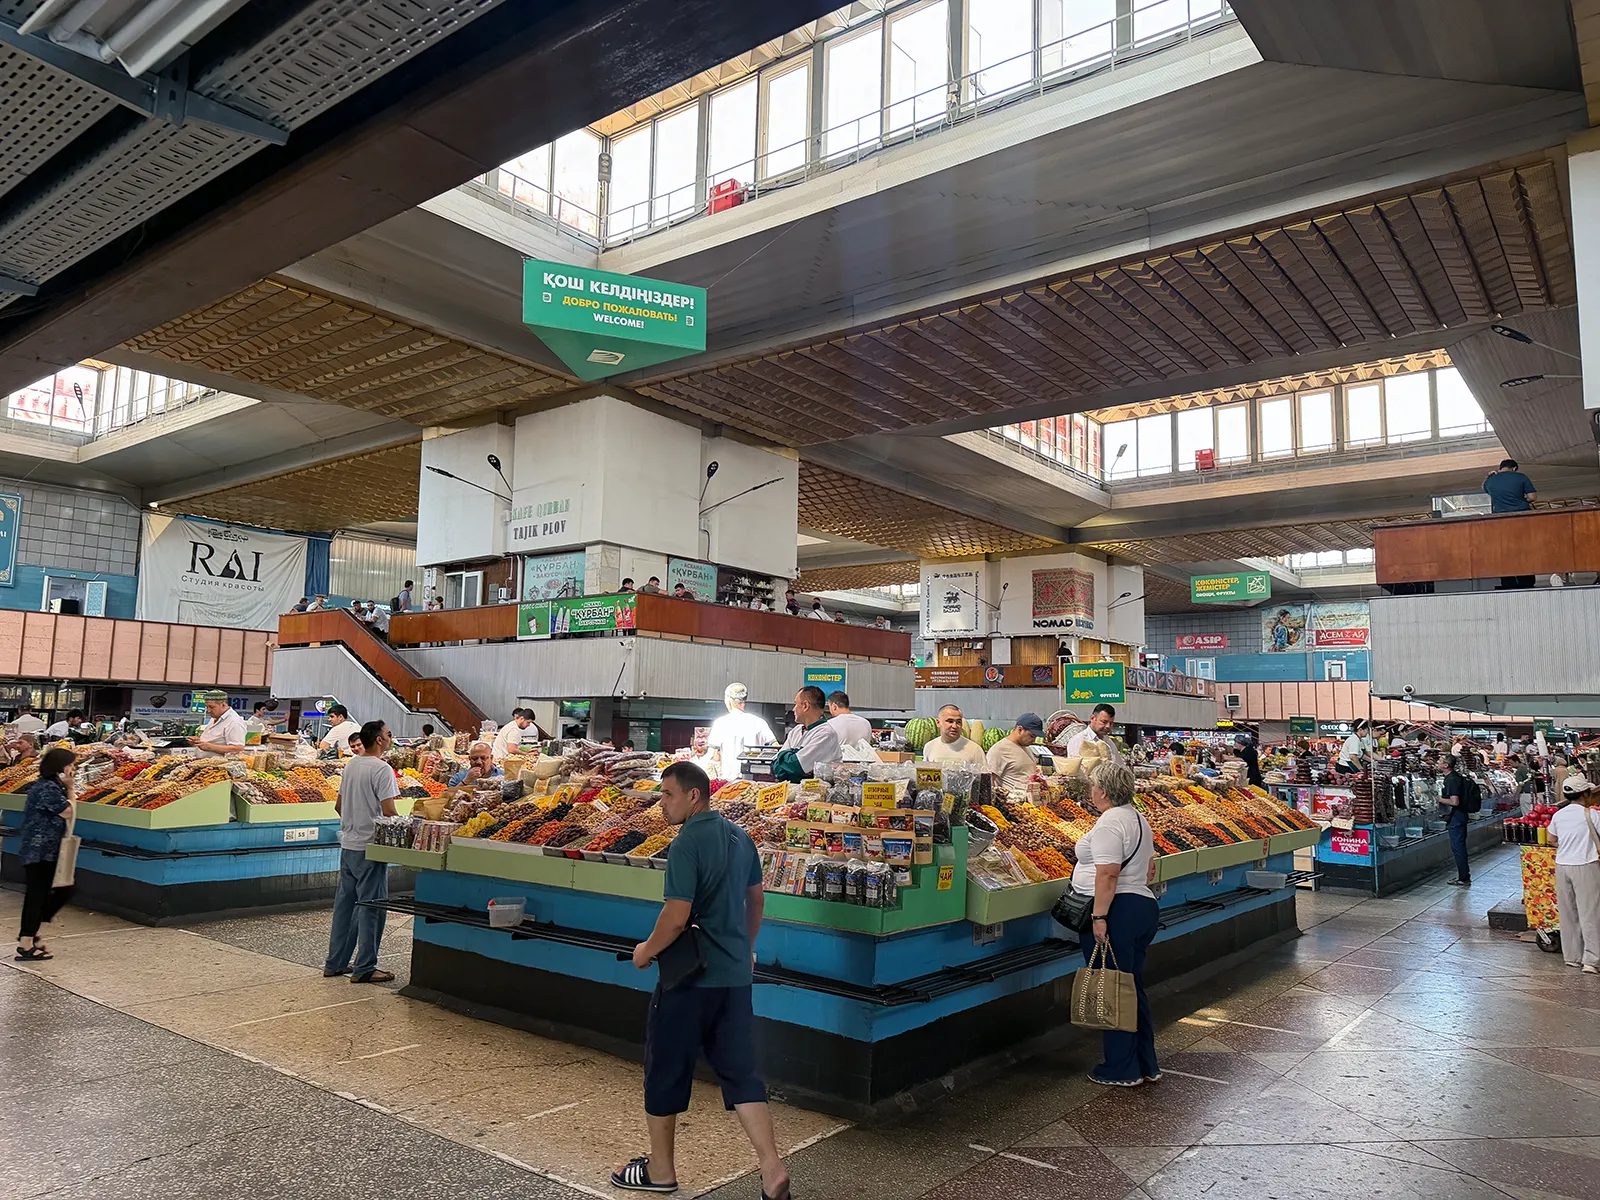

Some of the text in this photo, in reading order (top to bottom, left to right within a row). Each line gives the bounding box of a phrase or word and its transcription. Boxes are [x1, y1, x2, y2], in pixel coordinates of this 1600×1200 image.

[543, 272, 695, 309] ҚОШ КЕЛДІҢІЗДЕР!
[562, 295, 678, 322] ДОБРО ПОЖАЛОВАТЬ!
[593, 312, 645, 329] WELCOME!
[513, 520, 567, 540] TAJIK PLOV
[186, 540, 264, 583] RAI
[181, 575, 265, 592] Студия красоты
[1033, 619, 1073, 628] NOMAD
[1195, 636, 1222, 644] ASIP
[918, 773, 941, 782] ЧАЙ
[1332, 837, 1368, 845] КОНИНА
[940, 870, 953, 881] ЧАЙ
[986, 926, 993, 935] 45
